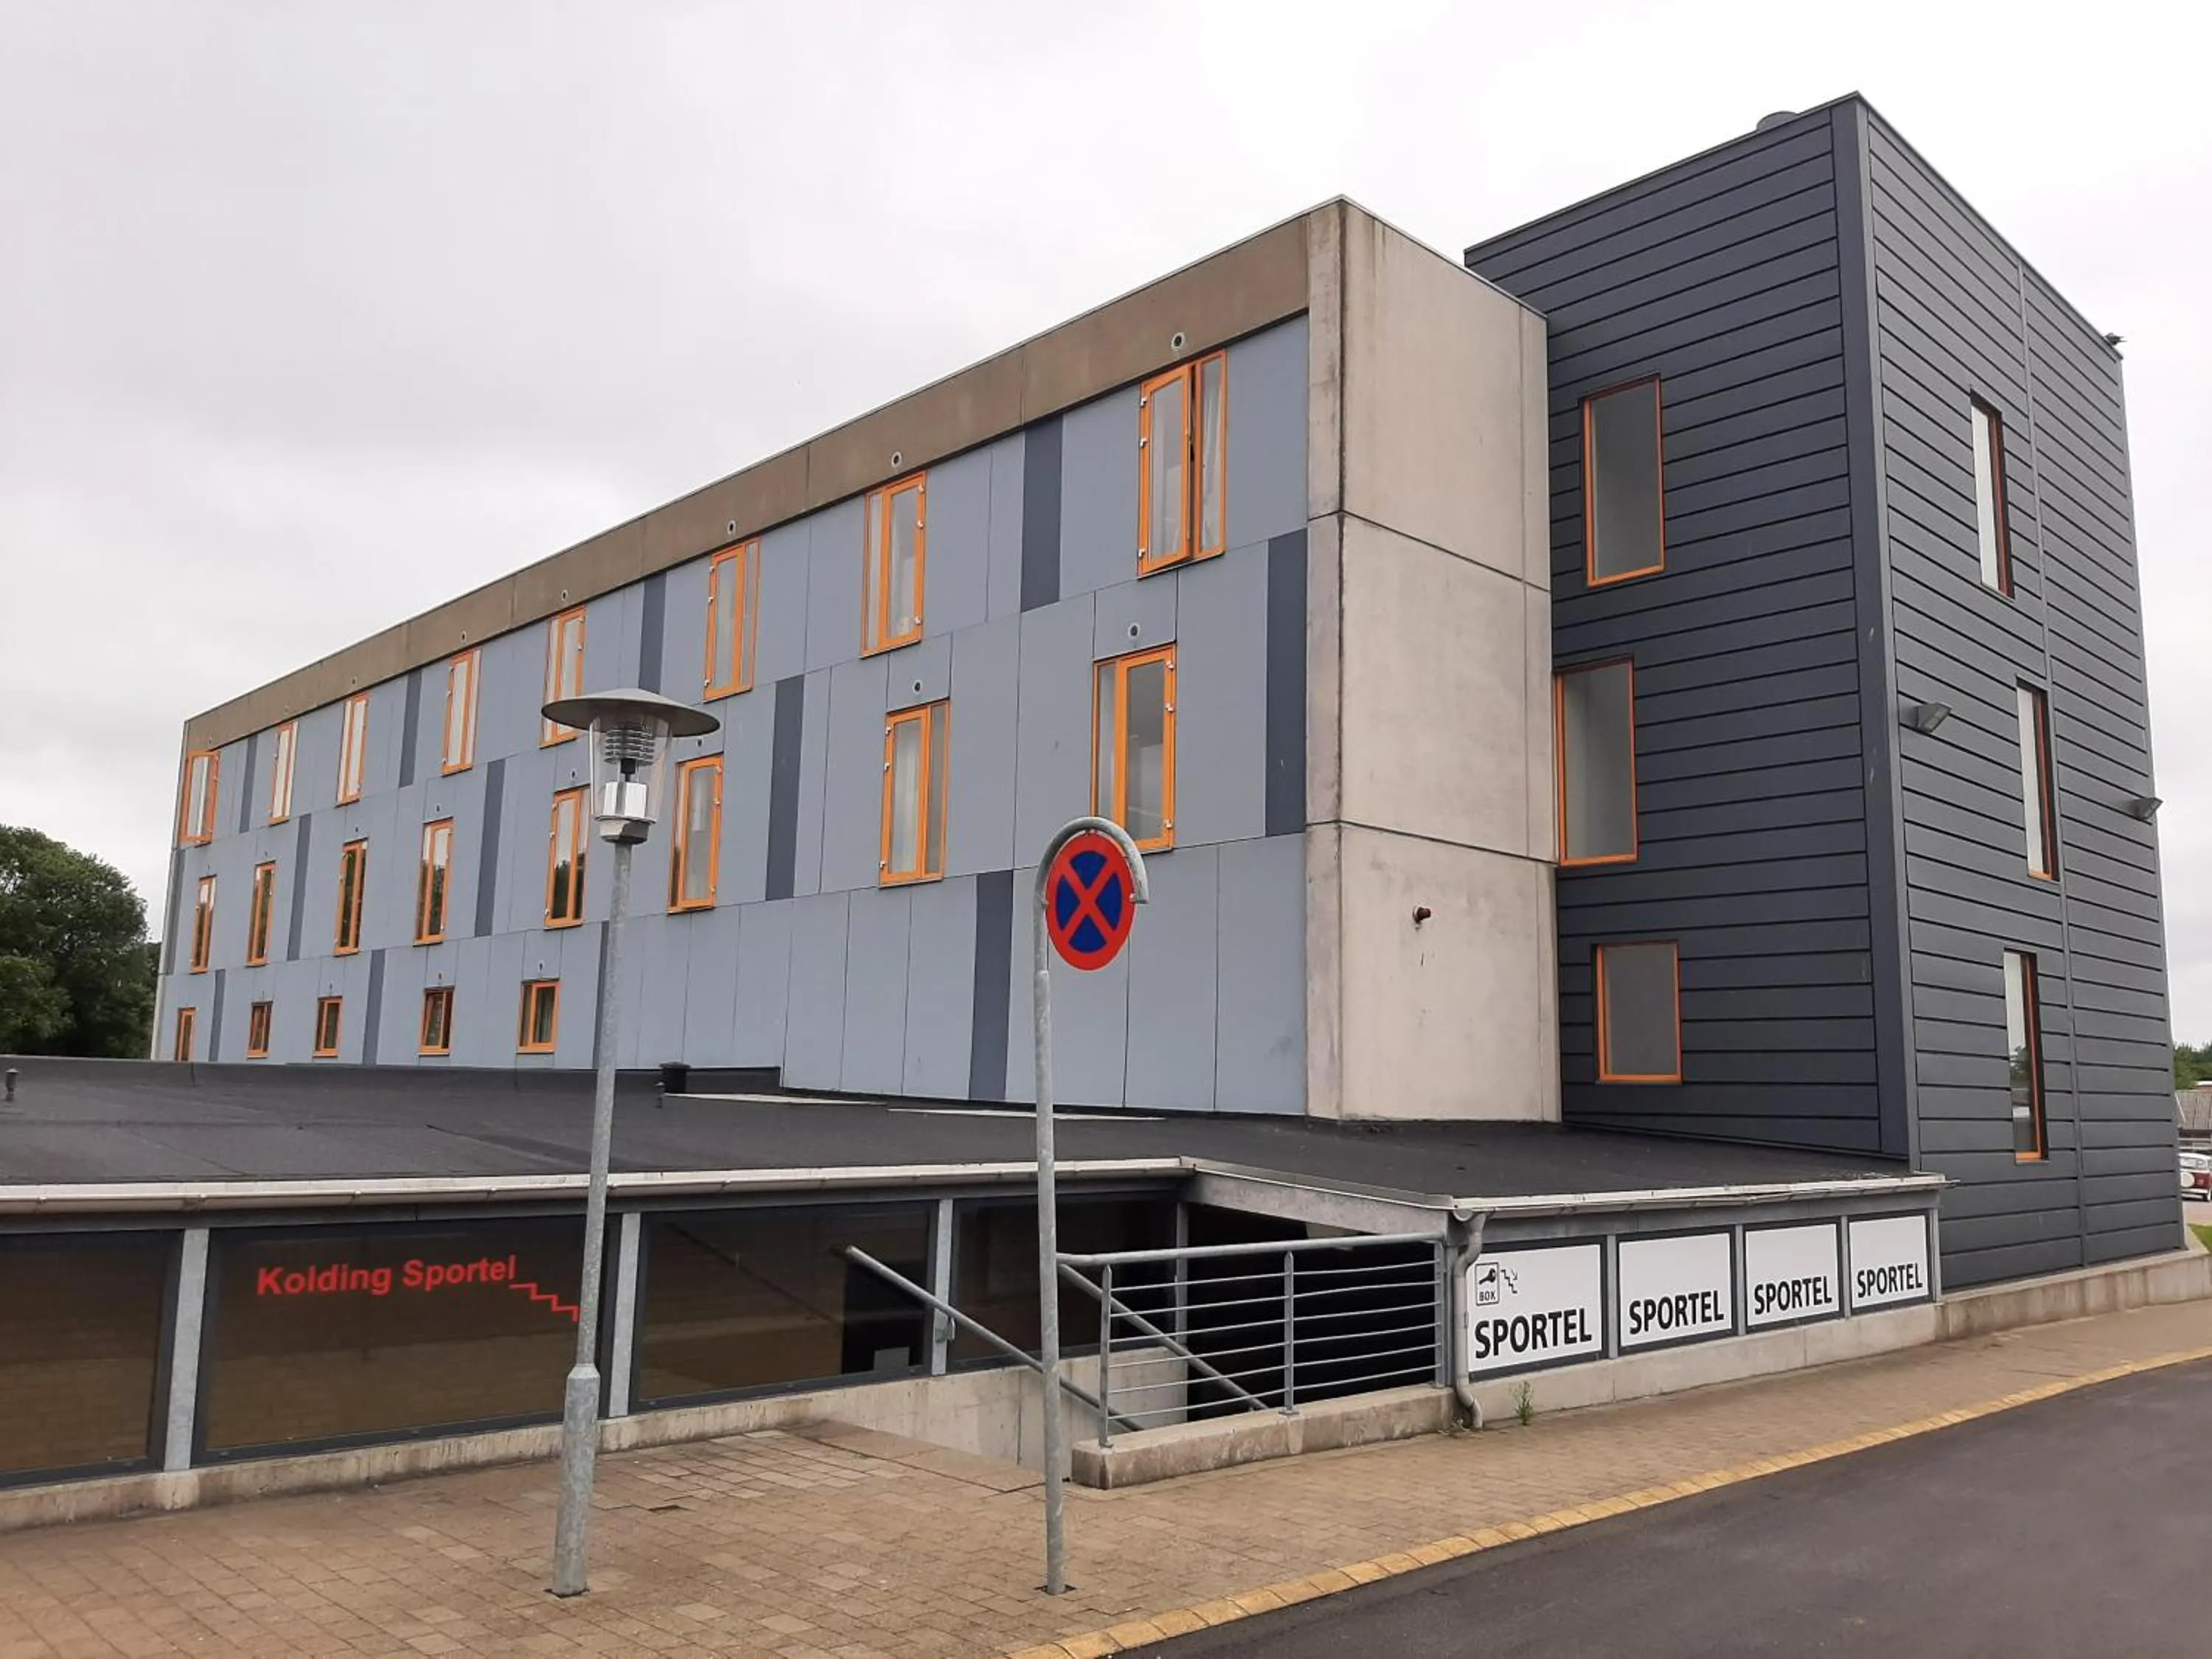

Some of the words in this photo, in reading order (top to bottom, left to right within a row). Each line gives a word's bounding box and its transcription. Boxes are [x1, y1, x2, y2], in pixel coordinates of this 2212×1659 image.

[257, 1263, 392, 1296] Kolding
[403, 1254, 516, 1292] Sportel
[1857, 1263, 1922, 1298] SPORTEL
[1478, 1290, 1496, 1301] BOX
[1629, 1290, 1724, 1335] SPORTEL
[1754, 1276, 1832, 1315] SPORTEL
[1475, 1308, 1592, 1359] SPORTEL
